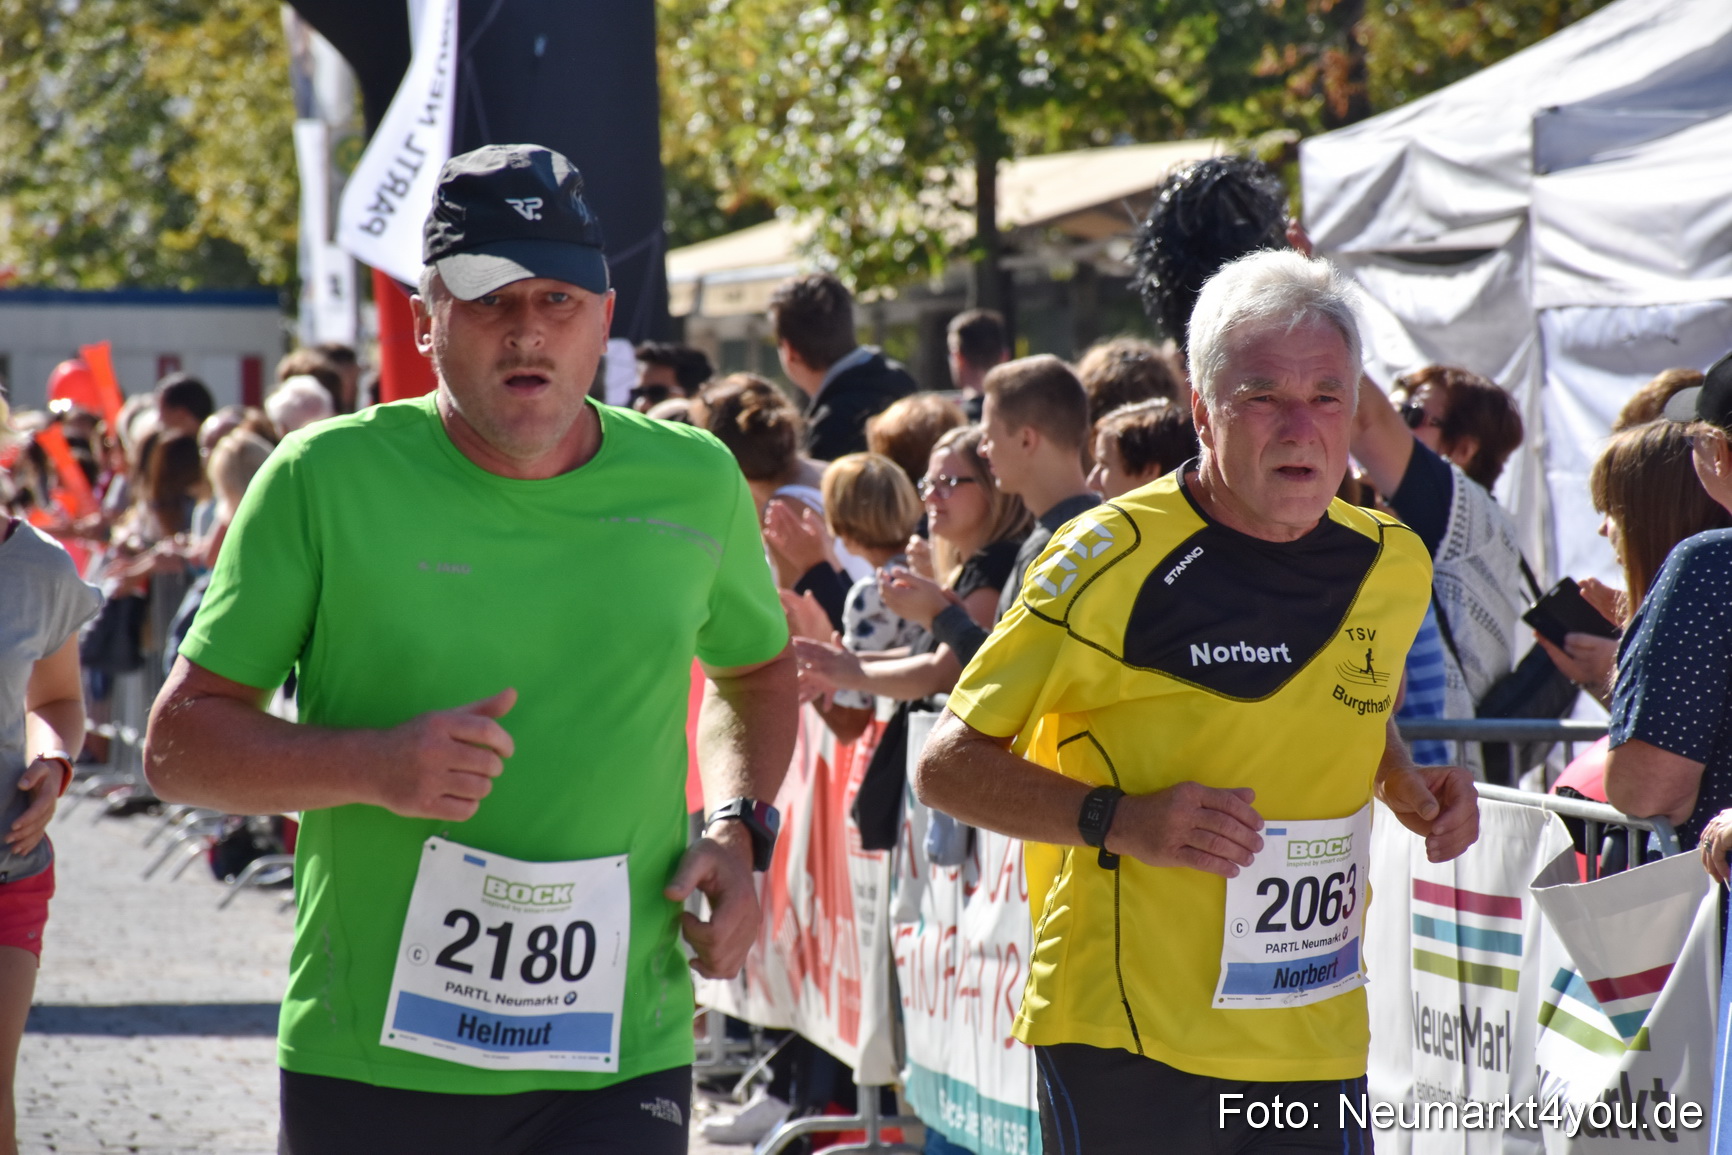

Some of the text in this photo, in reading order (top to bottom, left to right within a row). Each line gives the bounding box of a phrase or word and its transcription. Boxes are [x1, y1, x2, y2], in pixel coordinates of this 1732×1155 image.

[1163, 546, 1204, 585] STANNO
[1345, 627, 1376, 641] TSV
[1190, 641, 1292, 667] Norbert
[1287, 833, 1354, 860] BOCK
[483, 874, 575, 905] BOCK
[1255, 863, 1357, 933] 2063
[1236, 922, 1243, 934] C
[413, 948, 422, 961] C
[435, 907, 597, 985] 2180
[1265, 933, 1341, 954] PARTL Neumarkt
[1273, 957, 1338, 990] Norbert
[445, 981, 559, 1008] PARTL Neumarkt
[457, 1013, 552, 1046] Helmut
